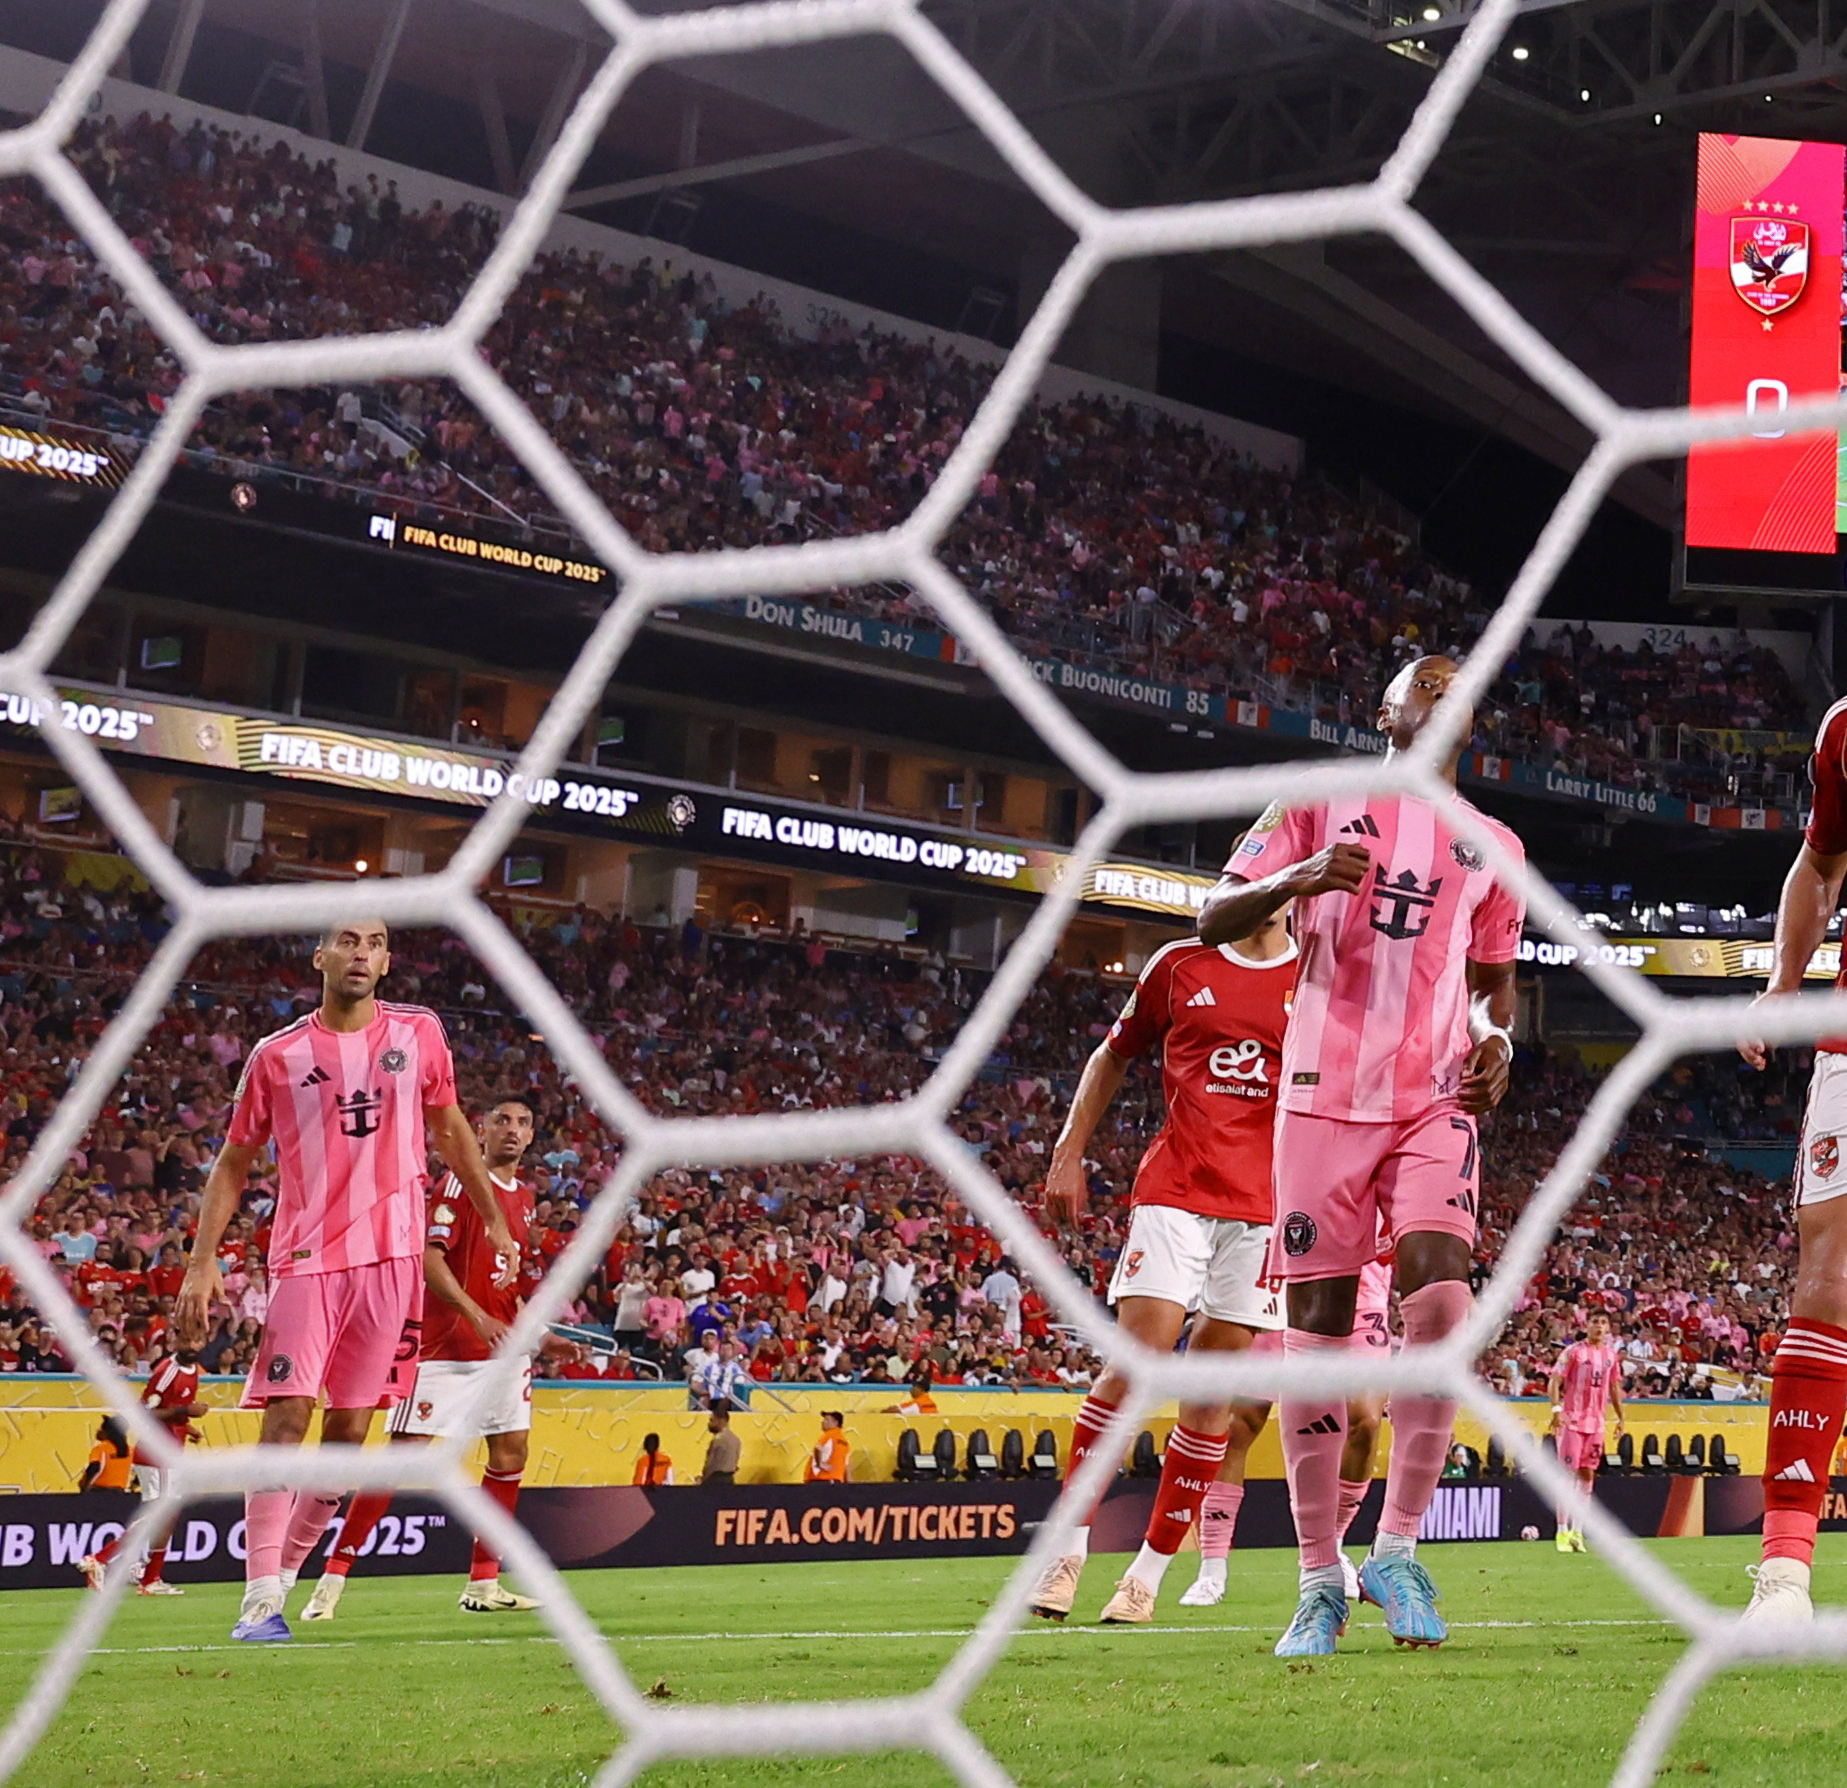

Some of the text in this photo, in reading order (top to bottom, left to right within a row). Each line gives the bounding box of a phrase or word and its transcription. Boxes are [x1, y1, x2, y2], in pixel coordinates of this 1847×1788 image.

[1746, 378, 1788, 439] 0
[404, 526, 437, 548] FIFA
[438, 534, 477, 556] CLUB
[480, 543, 533, 568] WORLD
[534, 554, 563, 574] CUP
[745, 594, 915, 652] DON SHULA 347
[1645, 627, 1687, 647] 324
[1060, 663, 1172, 709] BUONICONTI
[1186, 690, 1209, 714] 85
[1310, 718, 1340, 744] BILL
[260, 733, 322, 770] FIFA
[328, 744, 400, 781] CLUB
[405, 757, 503, 798] WORLD
[506, 775, 561, 806] CUP
[1546, 771, 1657, 813] LARRY LITTLE 66
[721, 807, 773, 841] FIFA
[775, 817, 834, 850] CLUB
[837, 826, 918, 863] WORLD
[918, 840, 964, 868] CUP
[1094, 870, 1137, 898] FIFA
[1138, 876, 1187, 905] CLUB
[1536, 943, 1580, 966] CUP
[1247, 1085, 1269, 1098] and
[1450, 1116, 1478, 1181] 7
[1773, 1409, 1830, 1431] AHLY
[1174, 1475, 1213, 1493] AHLY
[715, 1504, 1016, 1546] FIFA.COM/TICKETS
